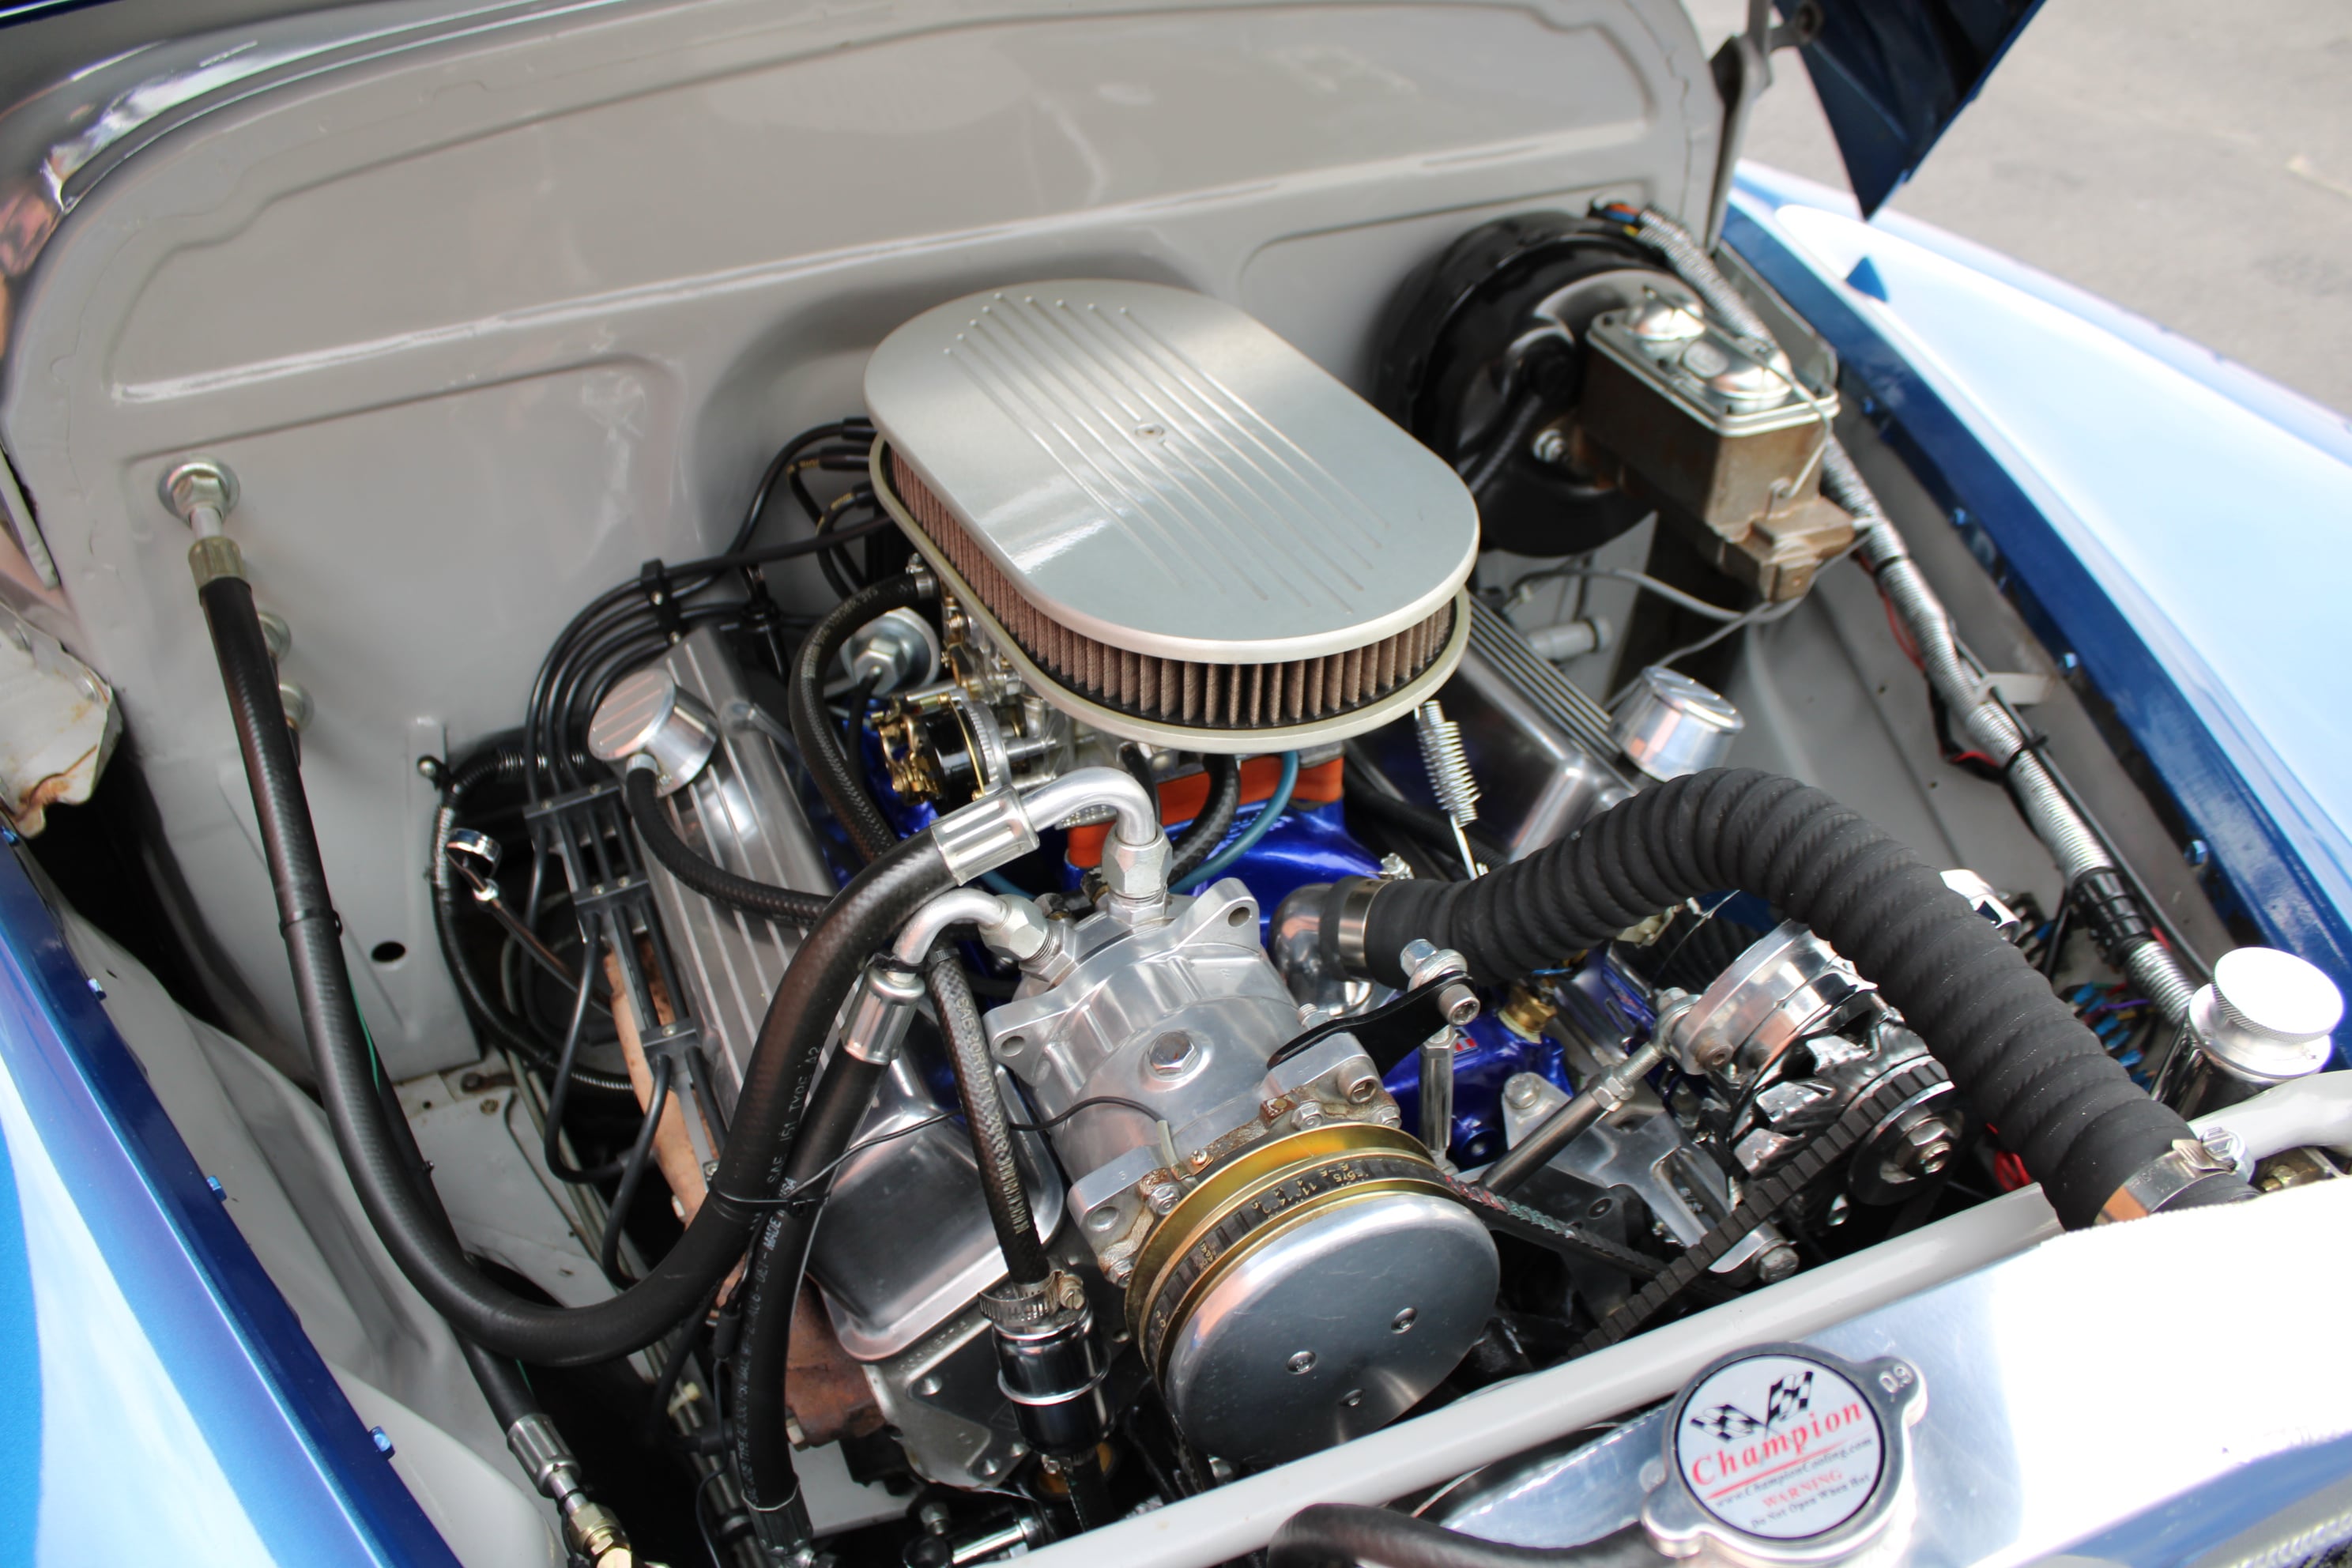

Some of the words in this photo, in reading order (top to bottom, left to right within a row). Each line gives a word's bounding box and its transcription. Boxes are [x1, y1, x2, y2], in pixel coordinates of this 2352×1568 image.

[956, 997, 975, 1029] SAE
[763, 1216, 782, 1250] MADE
[1691, 1401, 1862, 1486] Champion
[1762, 1469, 1843, 1508] WARNING
[1788, 1497, 1817, 1513] Open
[1818, 1483, 1848, 1498] When
